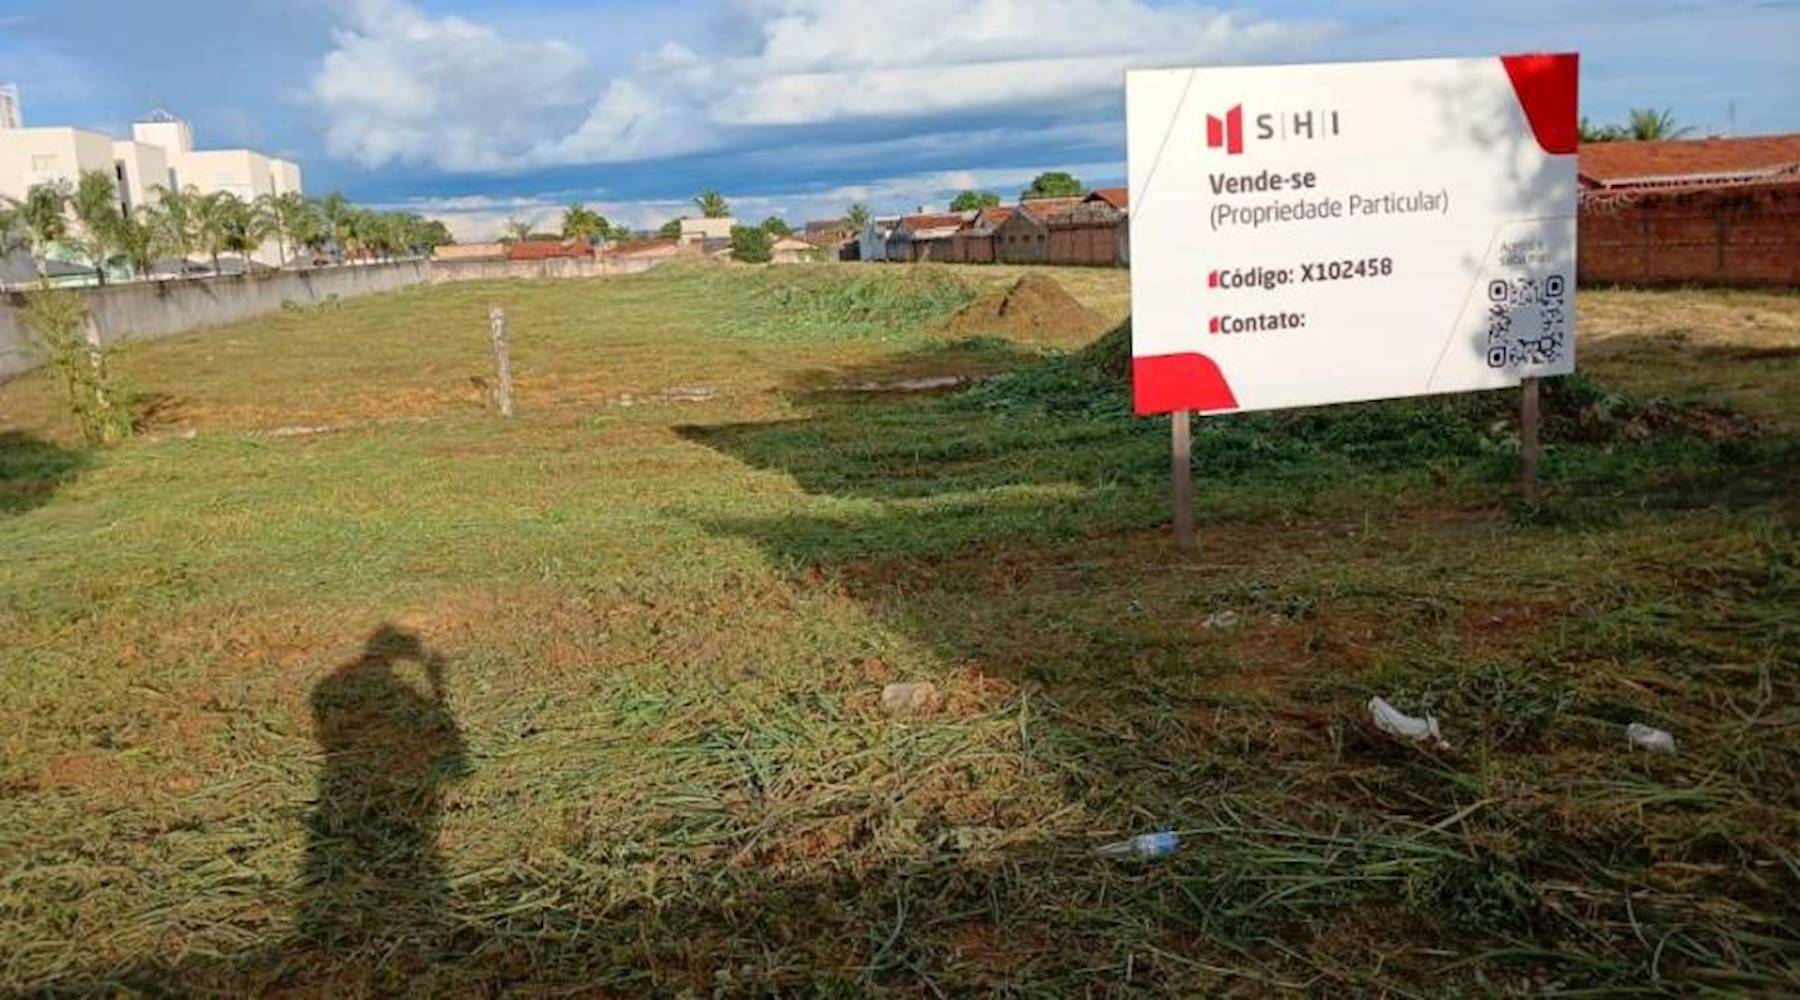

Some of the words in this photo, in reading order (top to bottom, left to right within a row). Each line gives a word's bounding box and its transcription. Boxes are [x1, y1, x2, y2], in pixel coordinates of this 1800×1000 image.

[1208, 170, 1317, 195] Vende-se
[1210, 197, 1343, 231] (Propriedade
[1348, 189, 1450, 216] Particular)
[1219, 267, 1294, 290] Código:
[1300, 256, 1394, 283] X102458
[1219, 311, 1307, 335] Contato:
